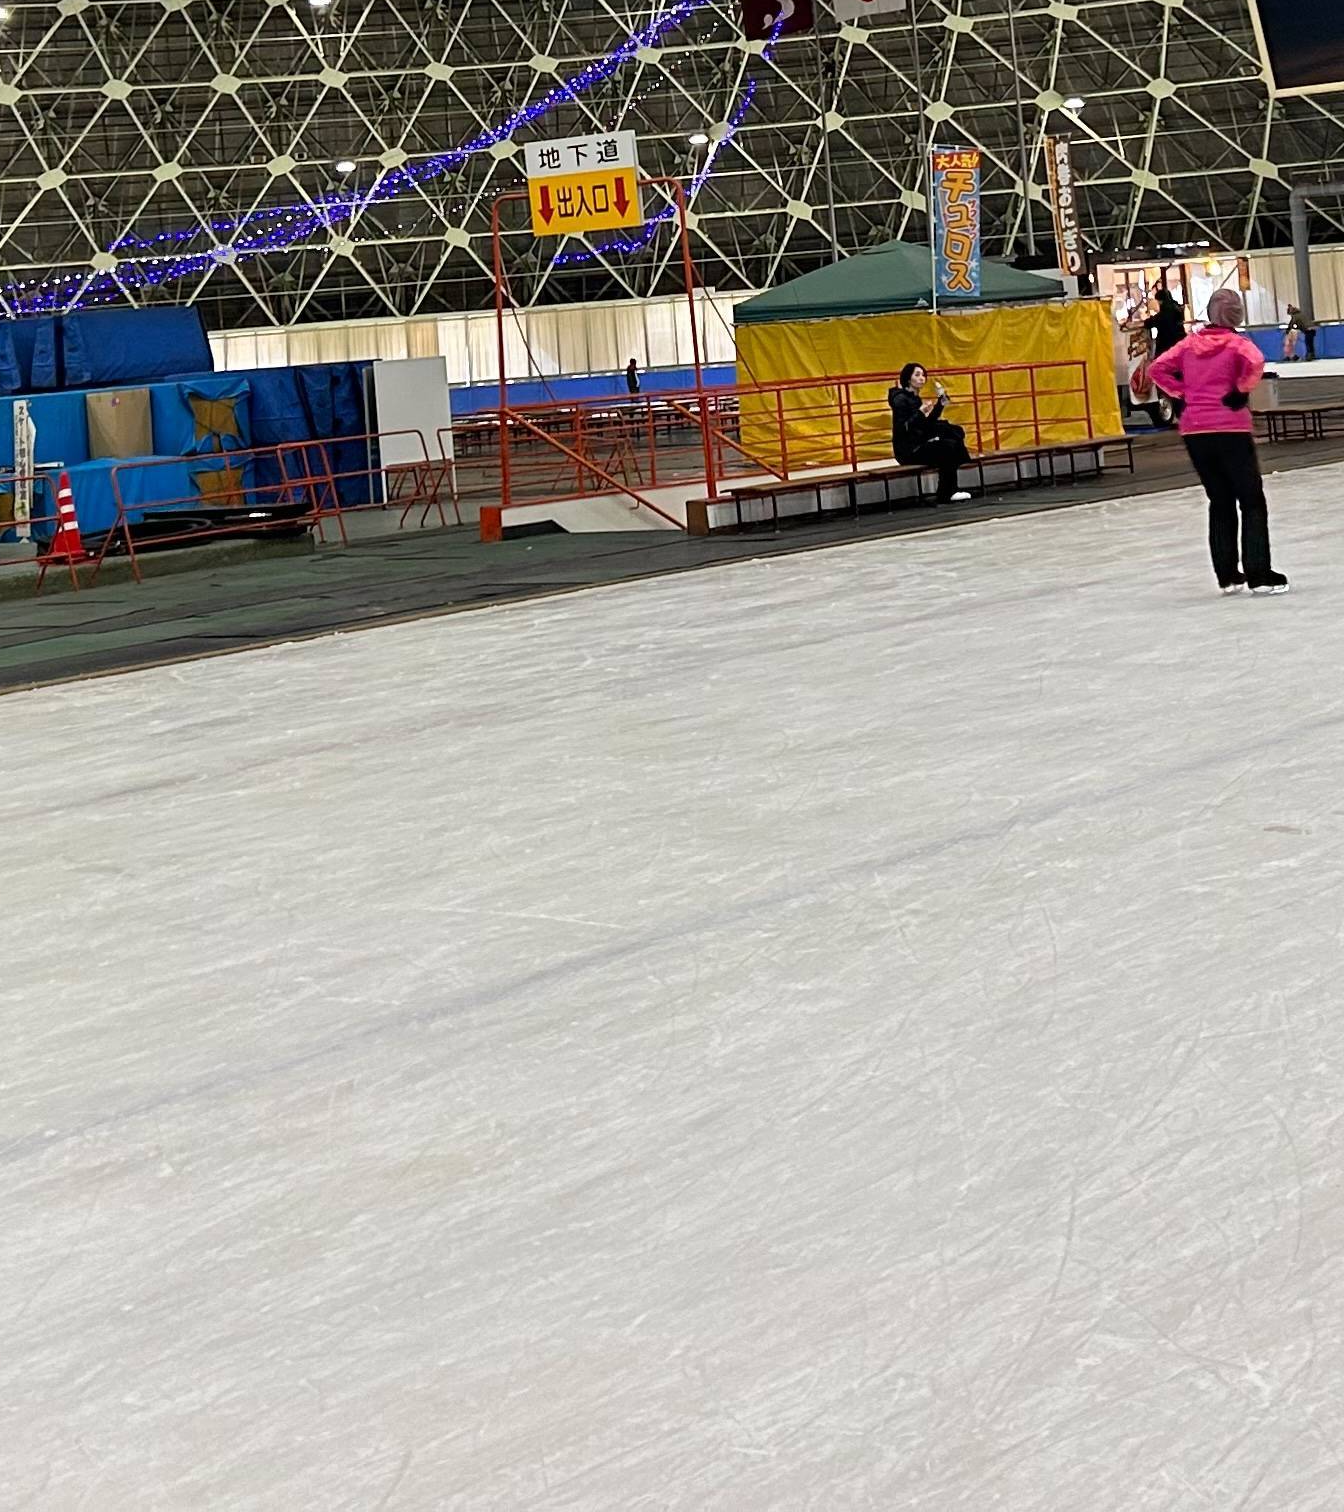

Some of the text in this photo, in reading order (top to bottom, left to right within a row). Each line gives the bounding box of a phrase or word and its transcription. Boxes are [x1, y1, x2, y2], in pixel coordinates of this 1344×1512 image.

[538, 138, 620, 169] 地下道
[556, 183, 610, 219] 出入口
[940, 170, 976, 292] チュロス
